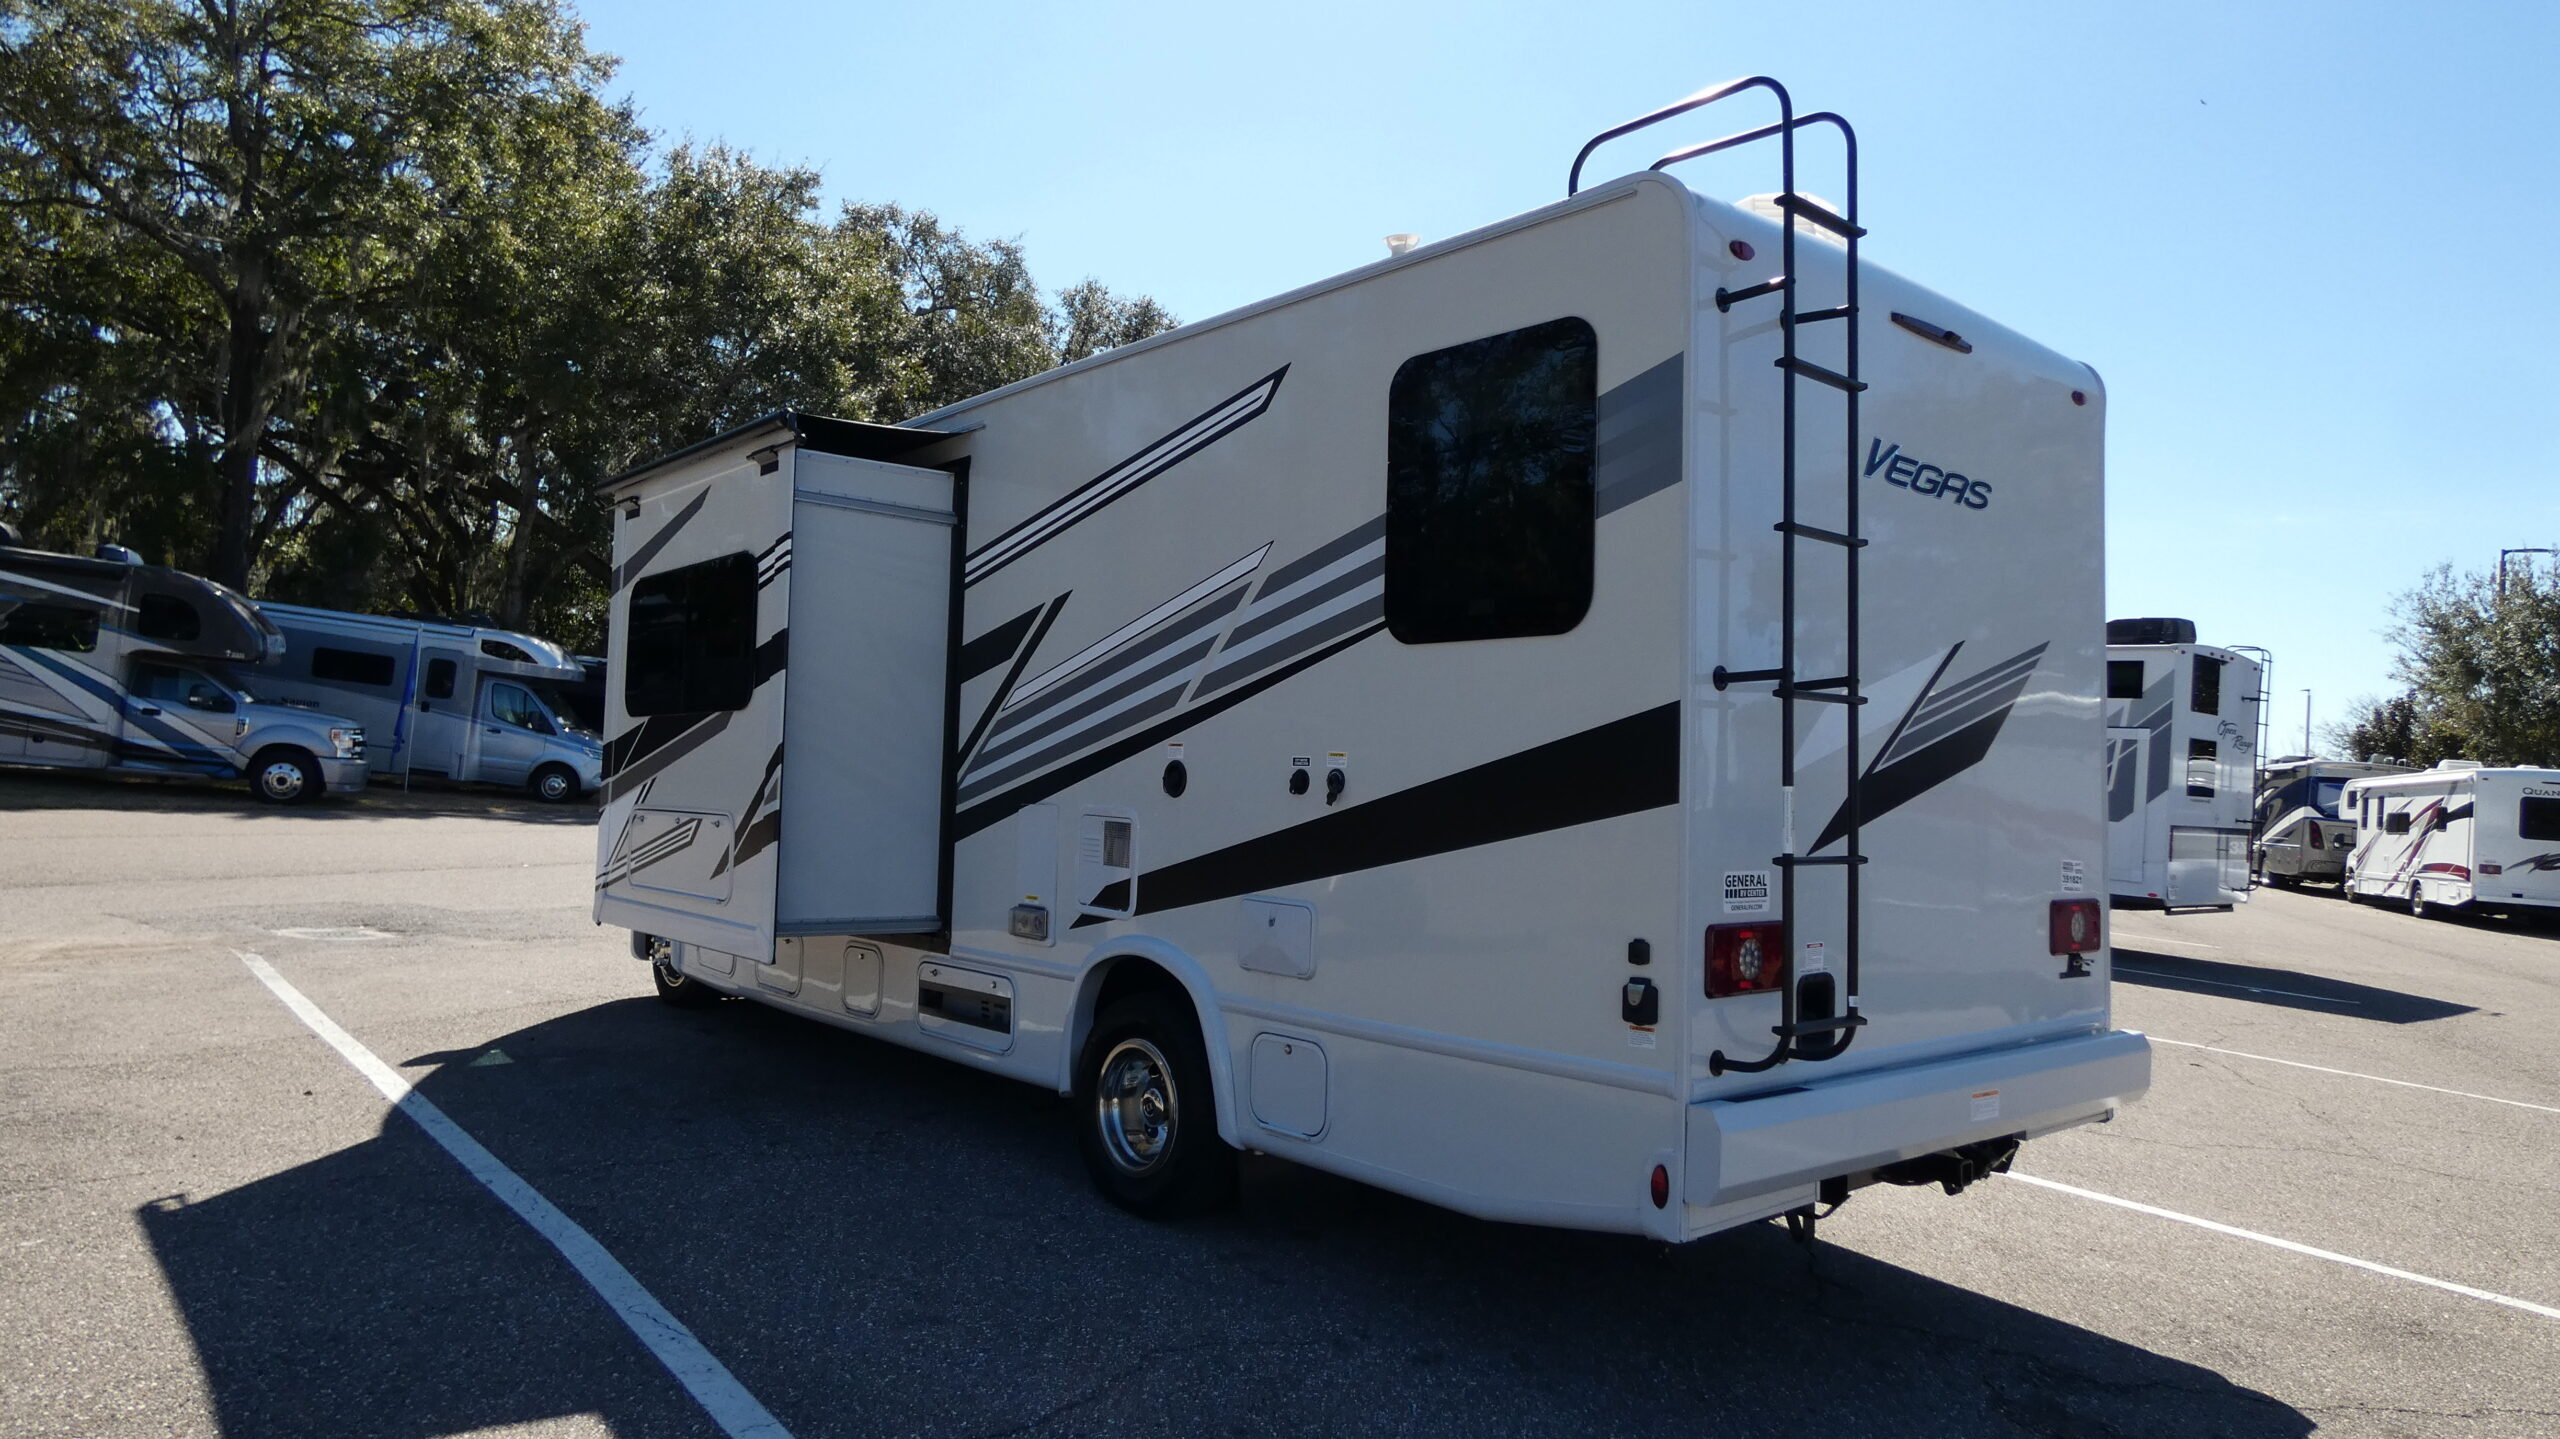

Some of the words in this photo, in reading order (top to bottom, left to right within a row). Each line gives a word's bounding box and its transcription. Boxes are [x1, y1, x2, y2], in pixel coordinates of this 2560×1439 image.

[1863, 437, 1993, 509] VEGAS
[1725, 874, 1767, 888] GENERAL
[1740, 889, 1747, 898] RV
[1747, 889, 1765, 897] CENTER
